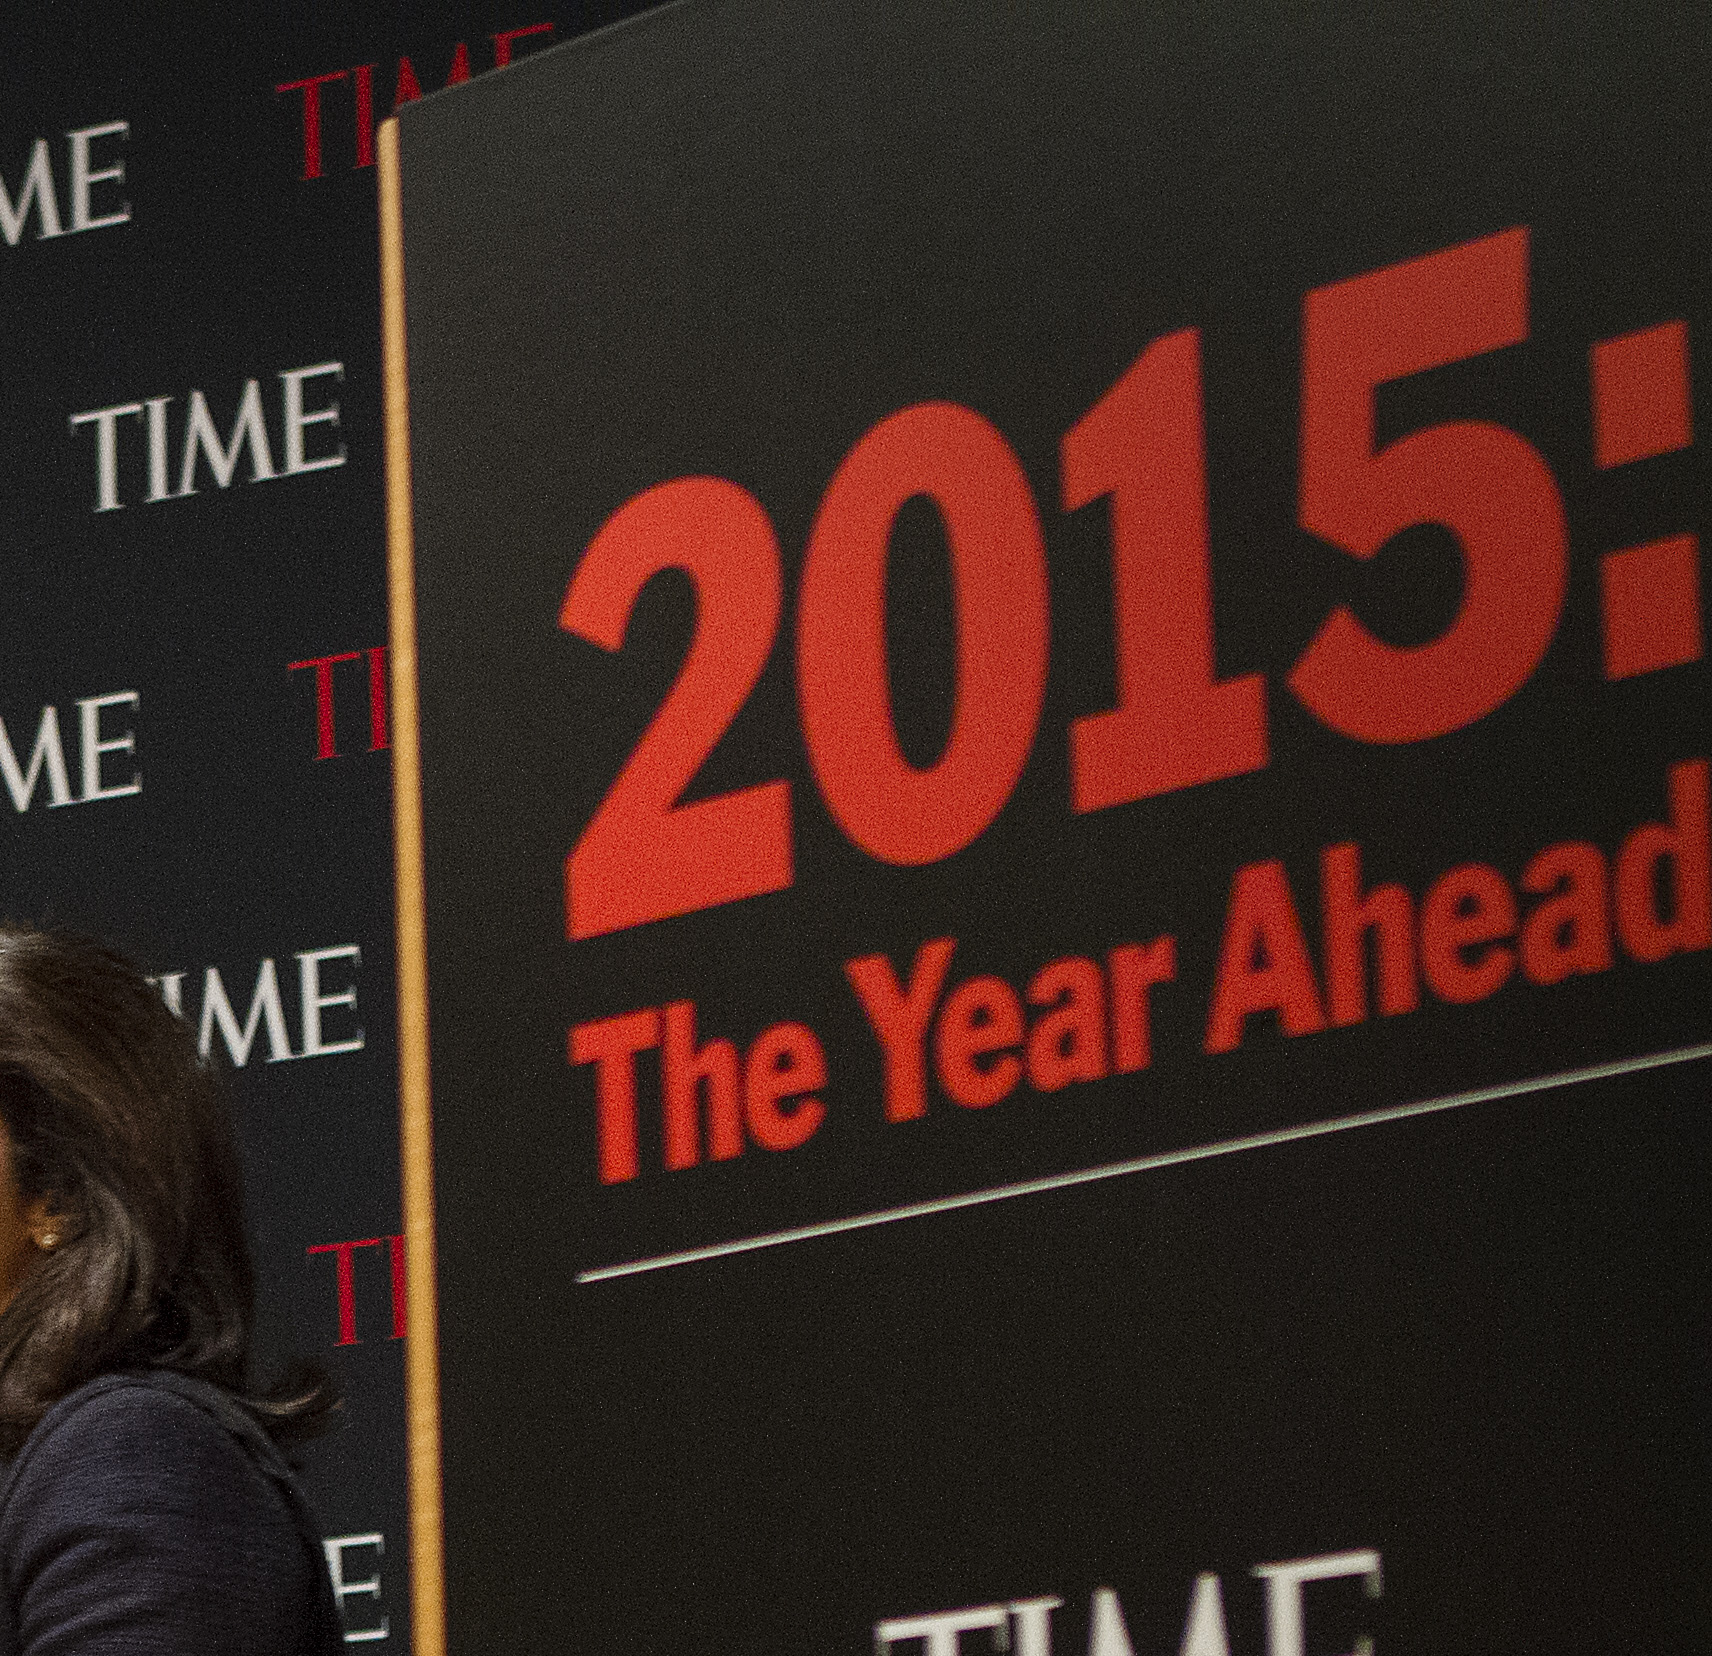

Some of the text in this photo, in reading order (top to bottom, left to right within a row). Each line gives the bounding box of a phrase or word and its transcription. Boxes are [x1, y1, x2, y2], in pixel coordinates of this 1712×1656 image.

[70, 362, 346, 511] TIME
[560, 226, 1702, 942] 2015:
[568, 758, 1712, 1185] The Year Ahead
